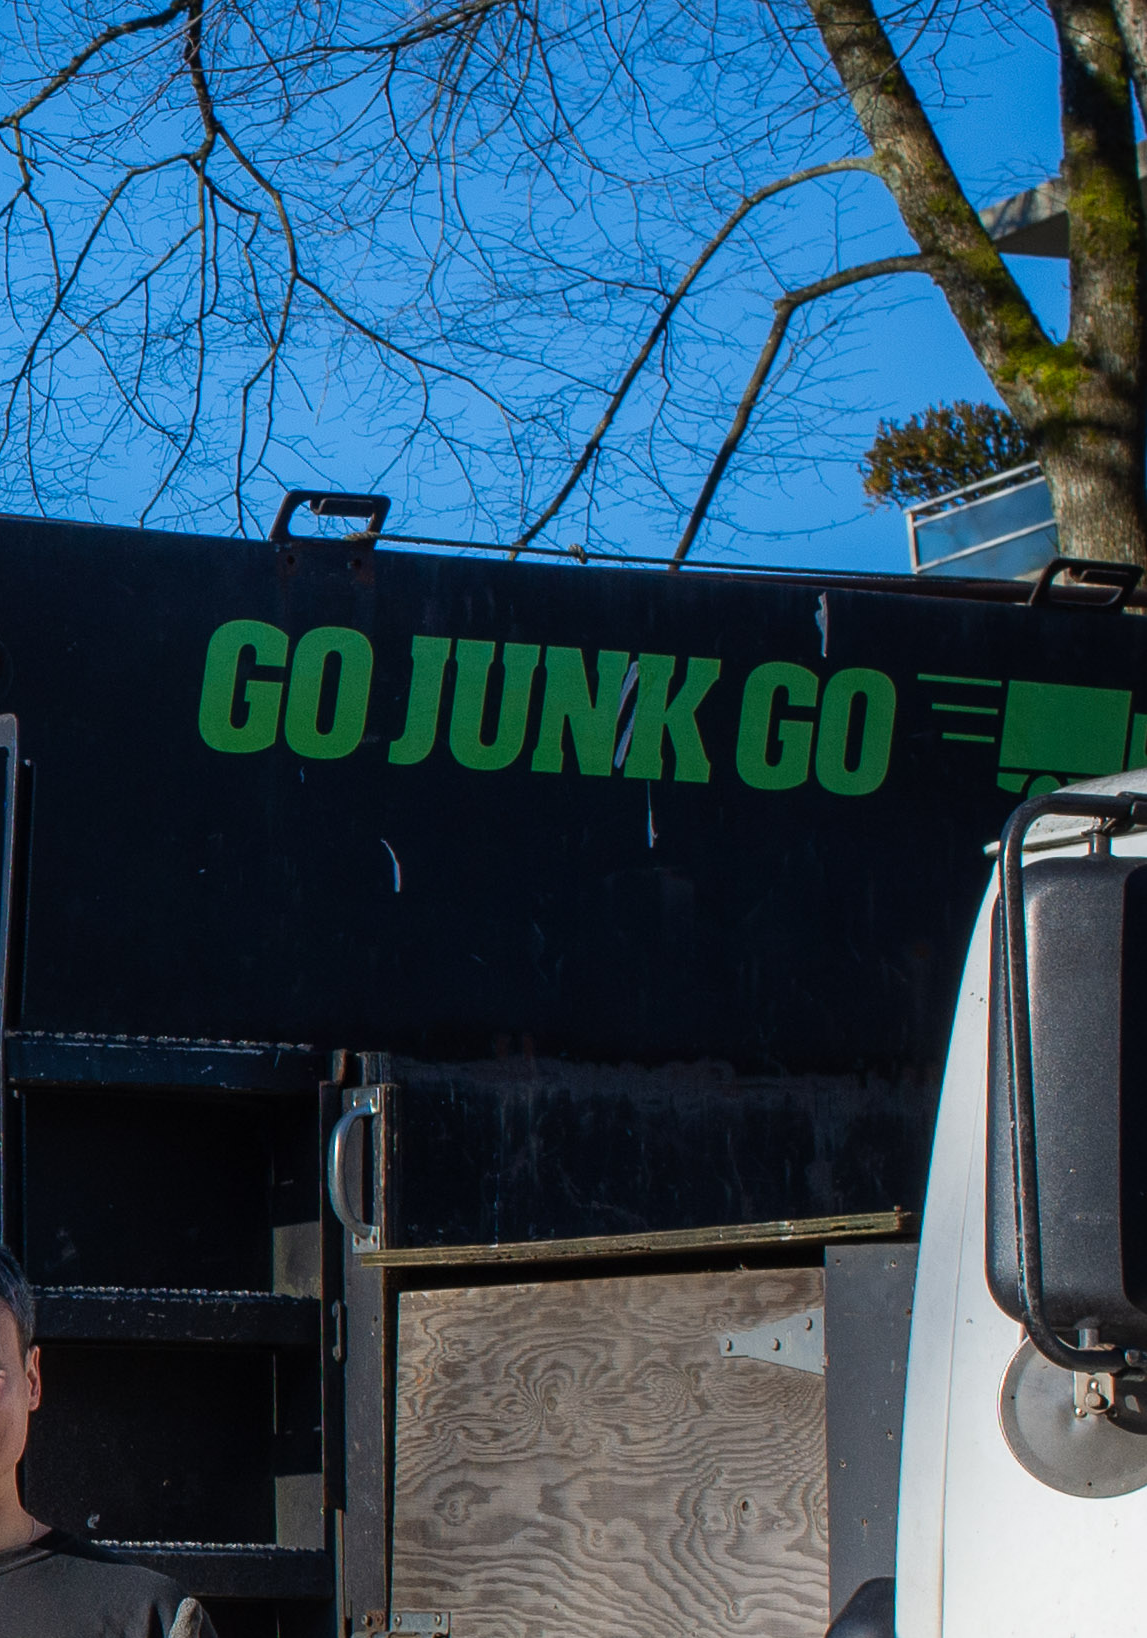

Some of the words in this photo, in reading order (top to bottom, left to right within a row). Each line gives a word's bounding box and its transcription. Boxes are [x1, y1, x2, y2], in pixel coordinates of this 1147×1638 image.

[198, 619, 374, 759] GO
[389, 635, 722, 783] JUNK
[737, 661, 896, 796] GO
